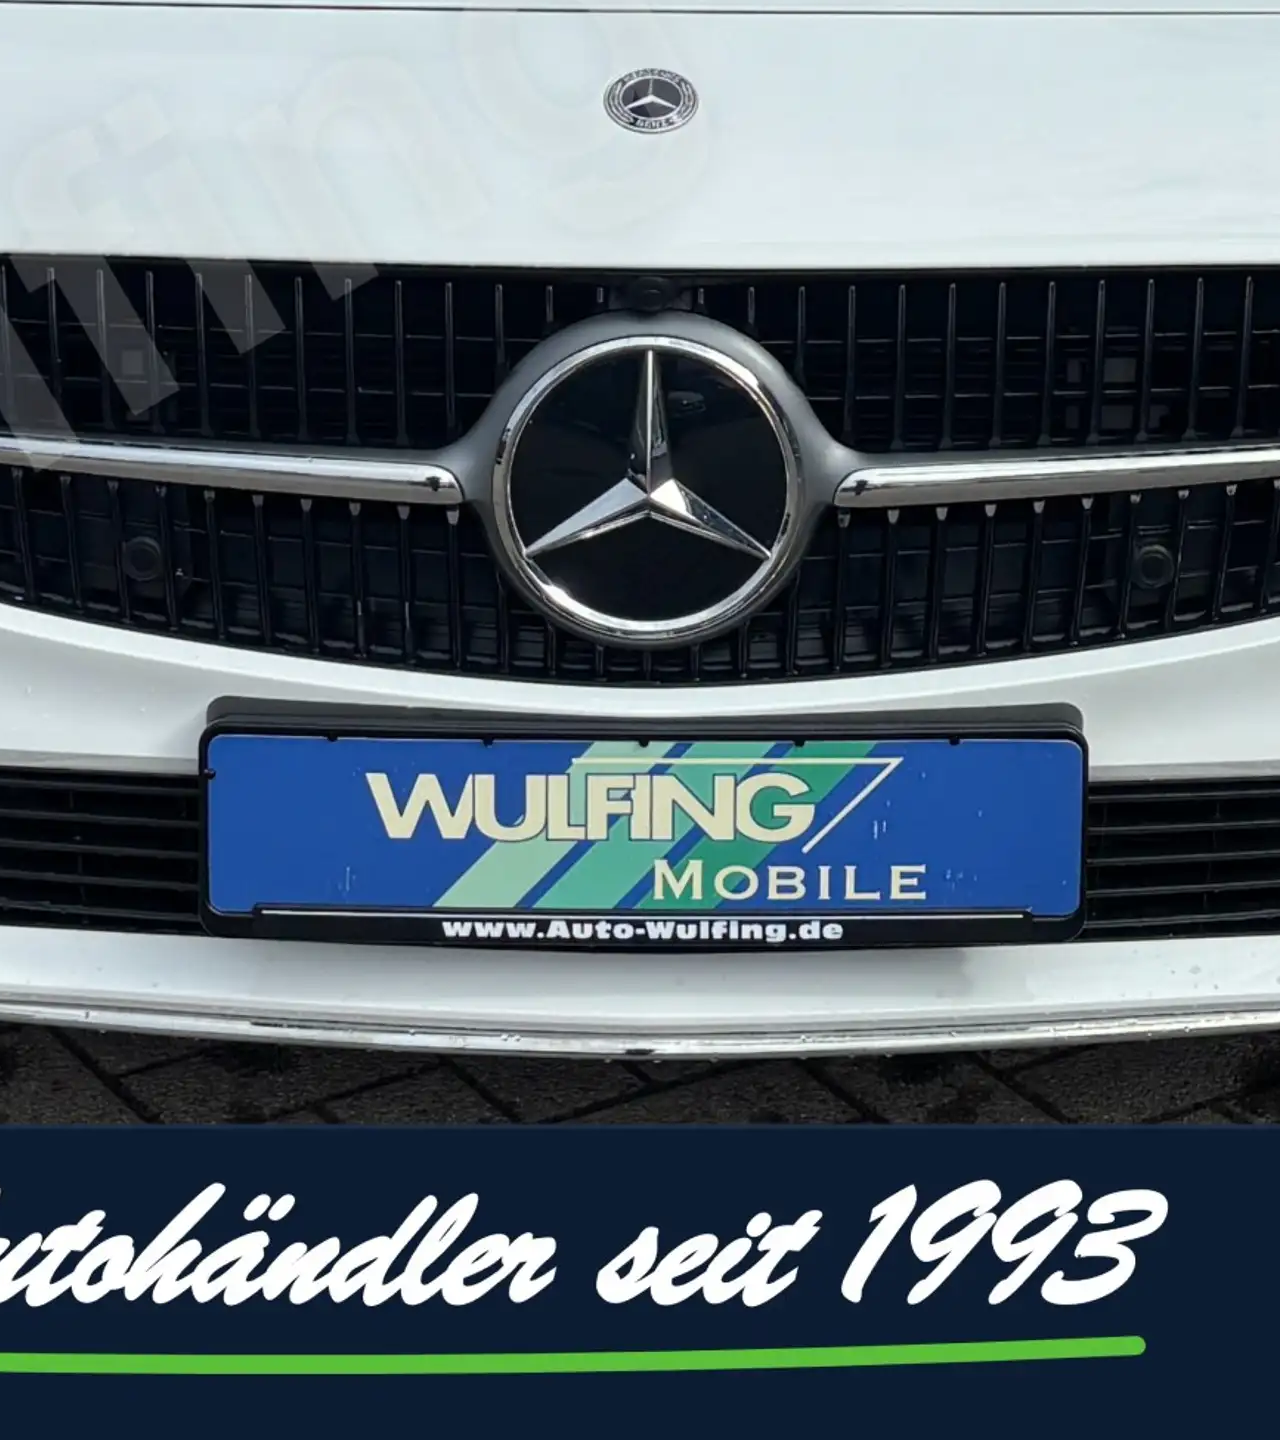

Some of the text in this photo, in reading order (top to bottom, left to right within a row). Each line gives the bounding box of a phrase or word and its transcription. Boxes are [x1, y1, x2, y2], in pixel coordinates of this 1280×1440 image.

[365, 771, 816, 843] WULFING
[652, 858, 928, 901] MOBILE
[441, 918, 845, 946] www.Auto-Wulfing.de
